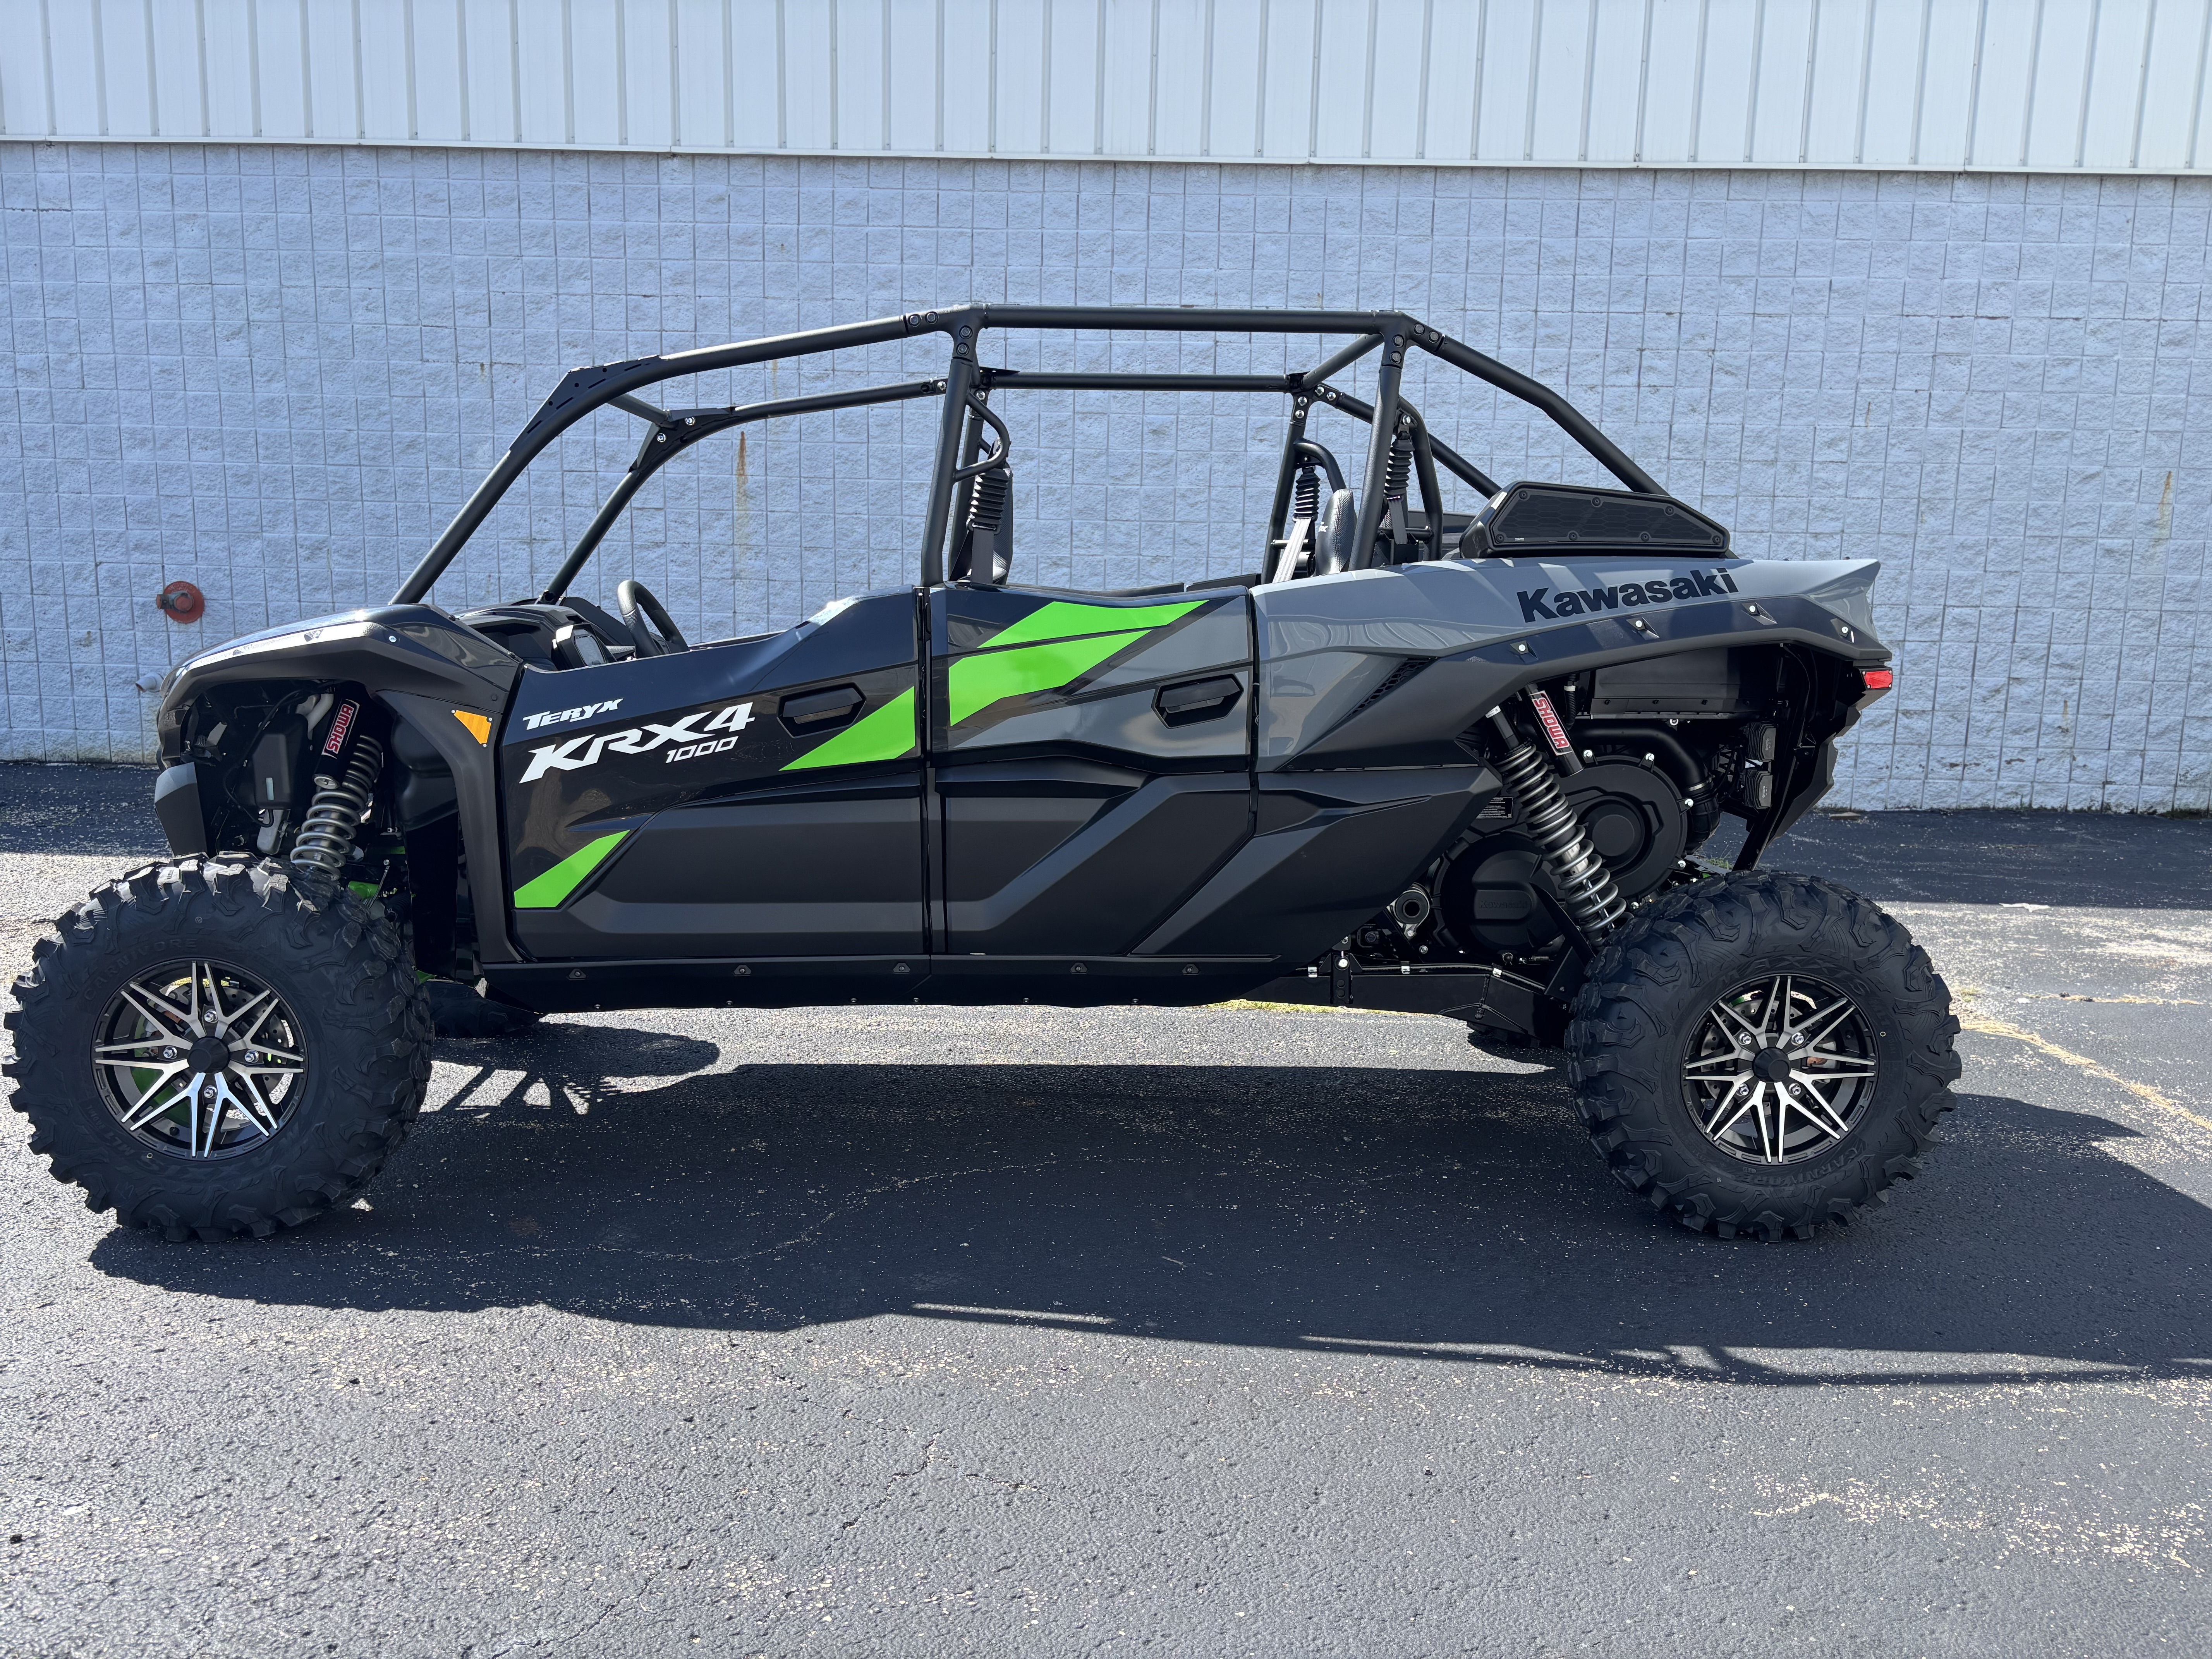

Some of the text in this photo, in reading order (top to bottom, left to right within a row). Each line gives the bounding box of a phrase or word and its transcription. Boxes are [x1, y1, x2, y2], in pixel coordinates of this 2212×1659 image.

[1516, 568, 1739, 623] Kawasaki
[326, 704, 354, 754] SHOWA
[522, 698, 623, 730] TERYX
[1533, 697, 1570, 749] SHOWA
[519, 702, 755, 783] KRX4
[665, 736, 739, 763] 1000
[1480, 900, 1528, 908] Kawasaki
[81, 938, 198, 1002] CARNIVORE
[1715, 955, 1872, 1000] MAXXIS
[134, 1121, 305, 1180] MAXXIS
[1739, 1145, 1860, 1186] CARNIVORE
